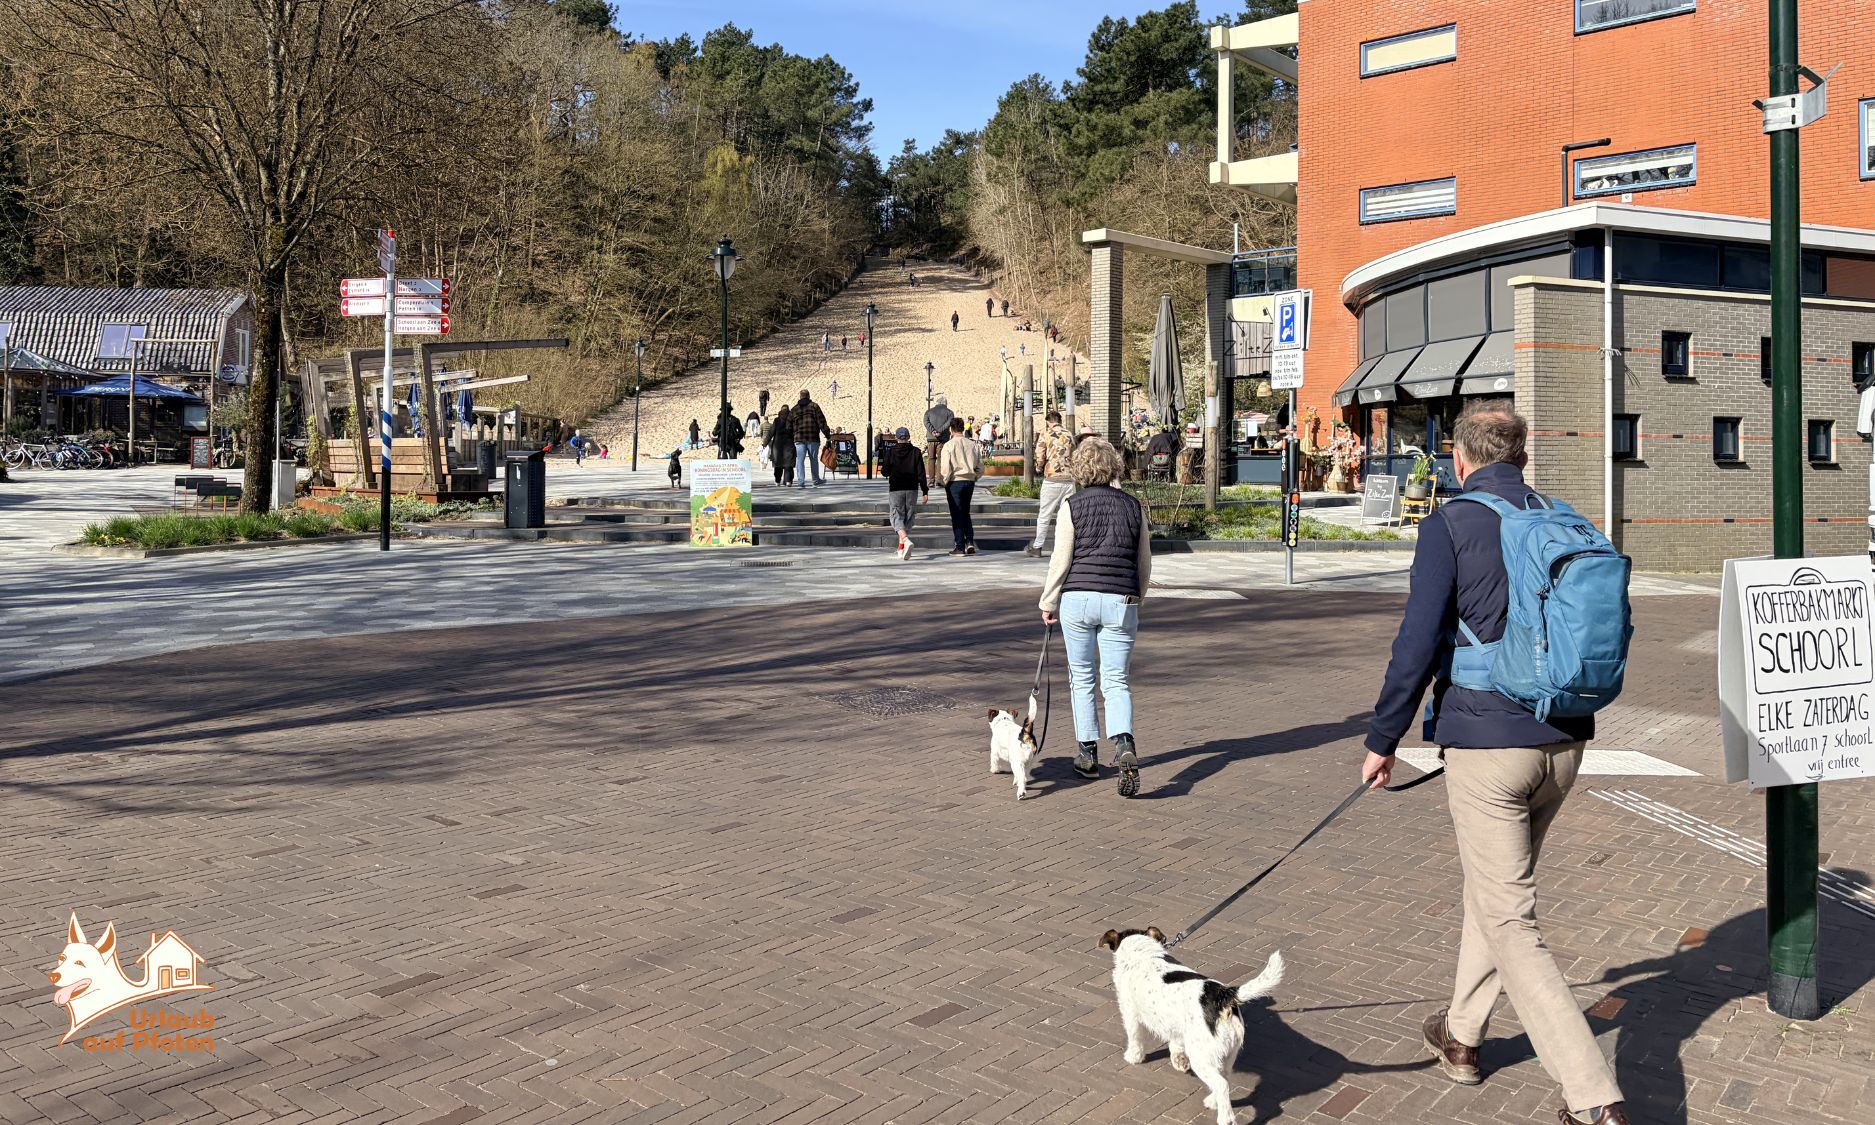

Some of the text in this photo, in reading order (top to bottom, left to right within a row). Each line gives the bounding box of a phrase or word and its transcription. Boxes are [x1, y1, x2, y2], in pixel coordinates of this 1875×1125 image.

[1283, 307, 1292, 326] P
[1224, 337, 1273, 358] ZilteZ
[1752, 587, 1864, 624] KOFFERBAKMARKT
[1759, 627, 1863, 674] SCHOORL
[1758, 693, 1869, 732] ELKE ZATERDAG
[1821, 735, 1828, 756] 7
[1828, 755, 1860, 769] entree
